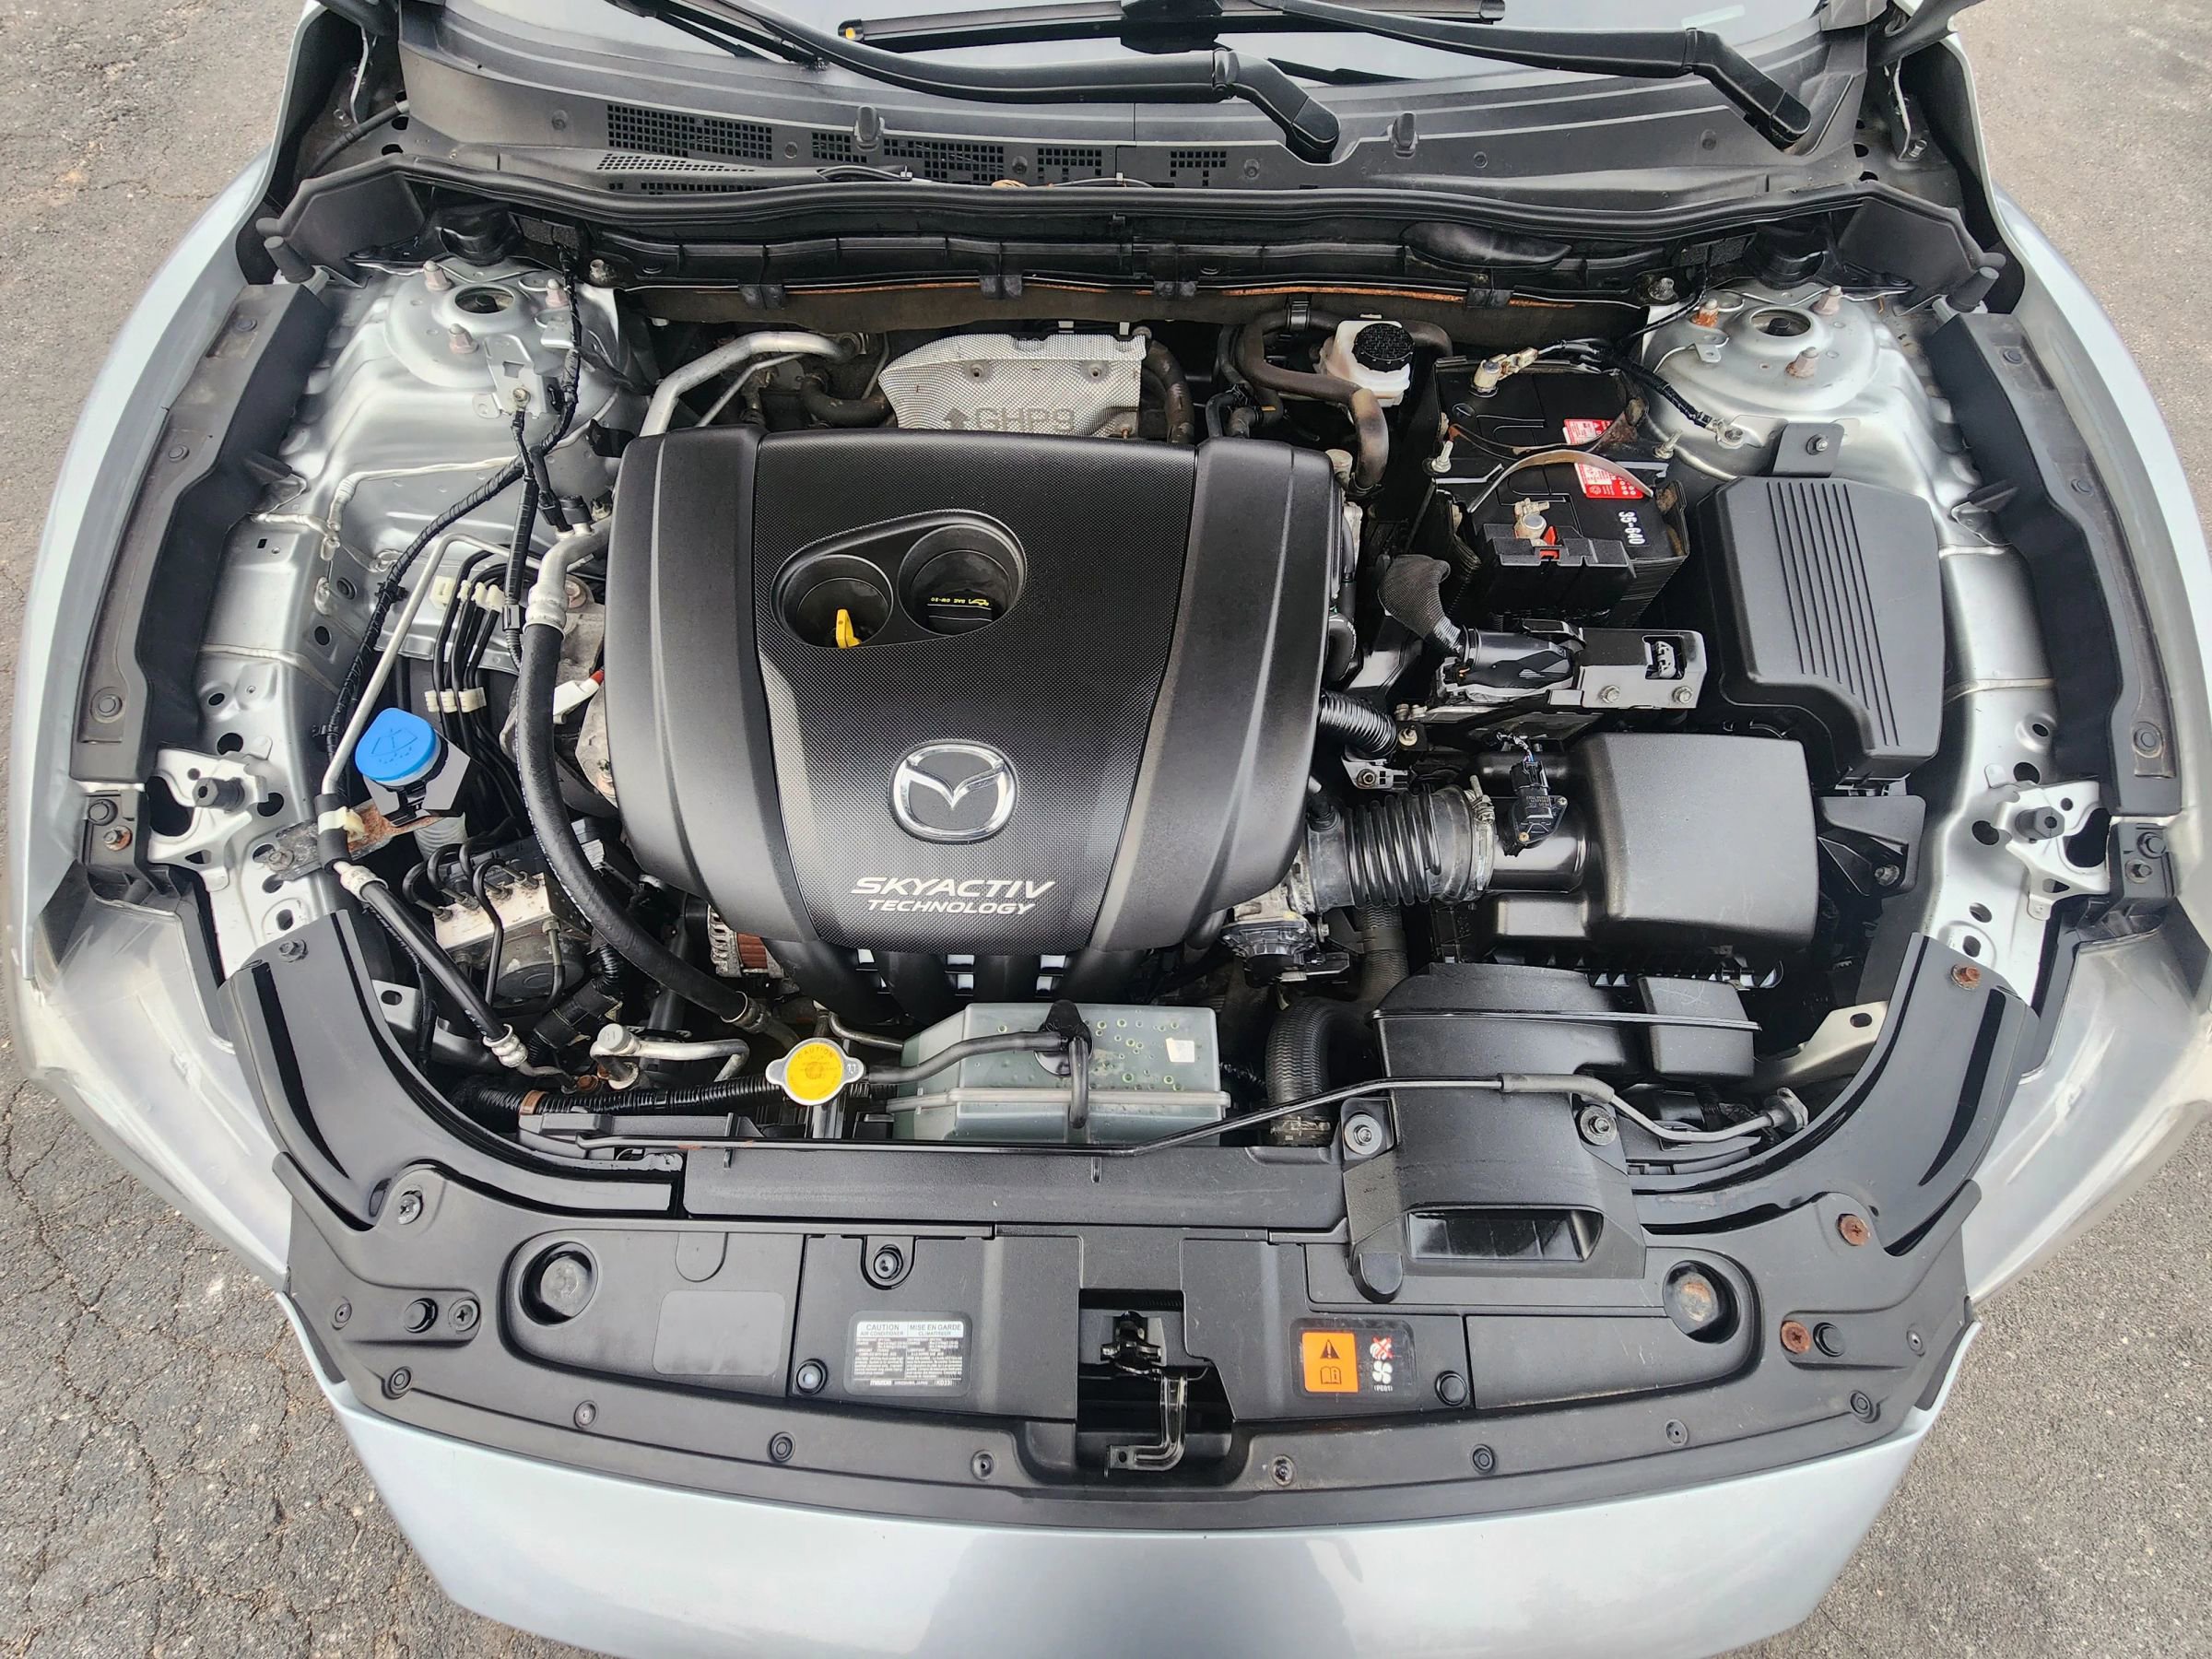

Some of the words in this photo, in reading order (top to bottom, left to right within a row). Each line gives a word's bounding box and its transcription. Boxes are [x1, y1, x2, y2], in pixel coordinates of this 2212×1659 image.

[975, 407, 1075, 431] GHP9
[1618, 511, 1646, 545] 35-640
[851, 877, 1055, 900] SKYACTIV
[867, 899, 1035, 914] TECHNOLOGY
[797, 1046, 834, 1059] CAUTION
